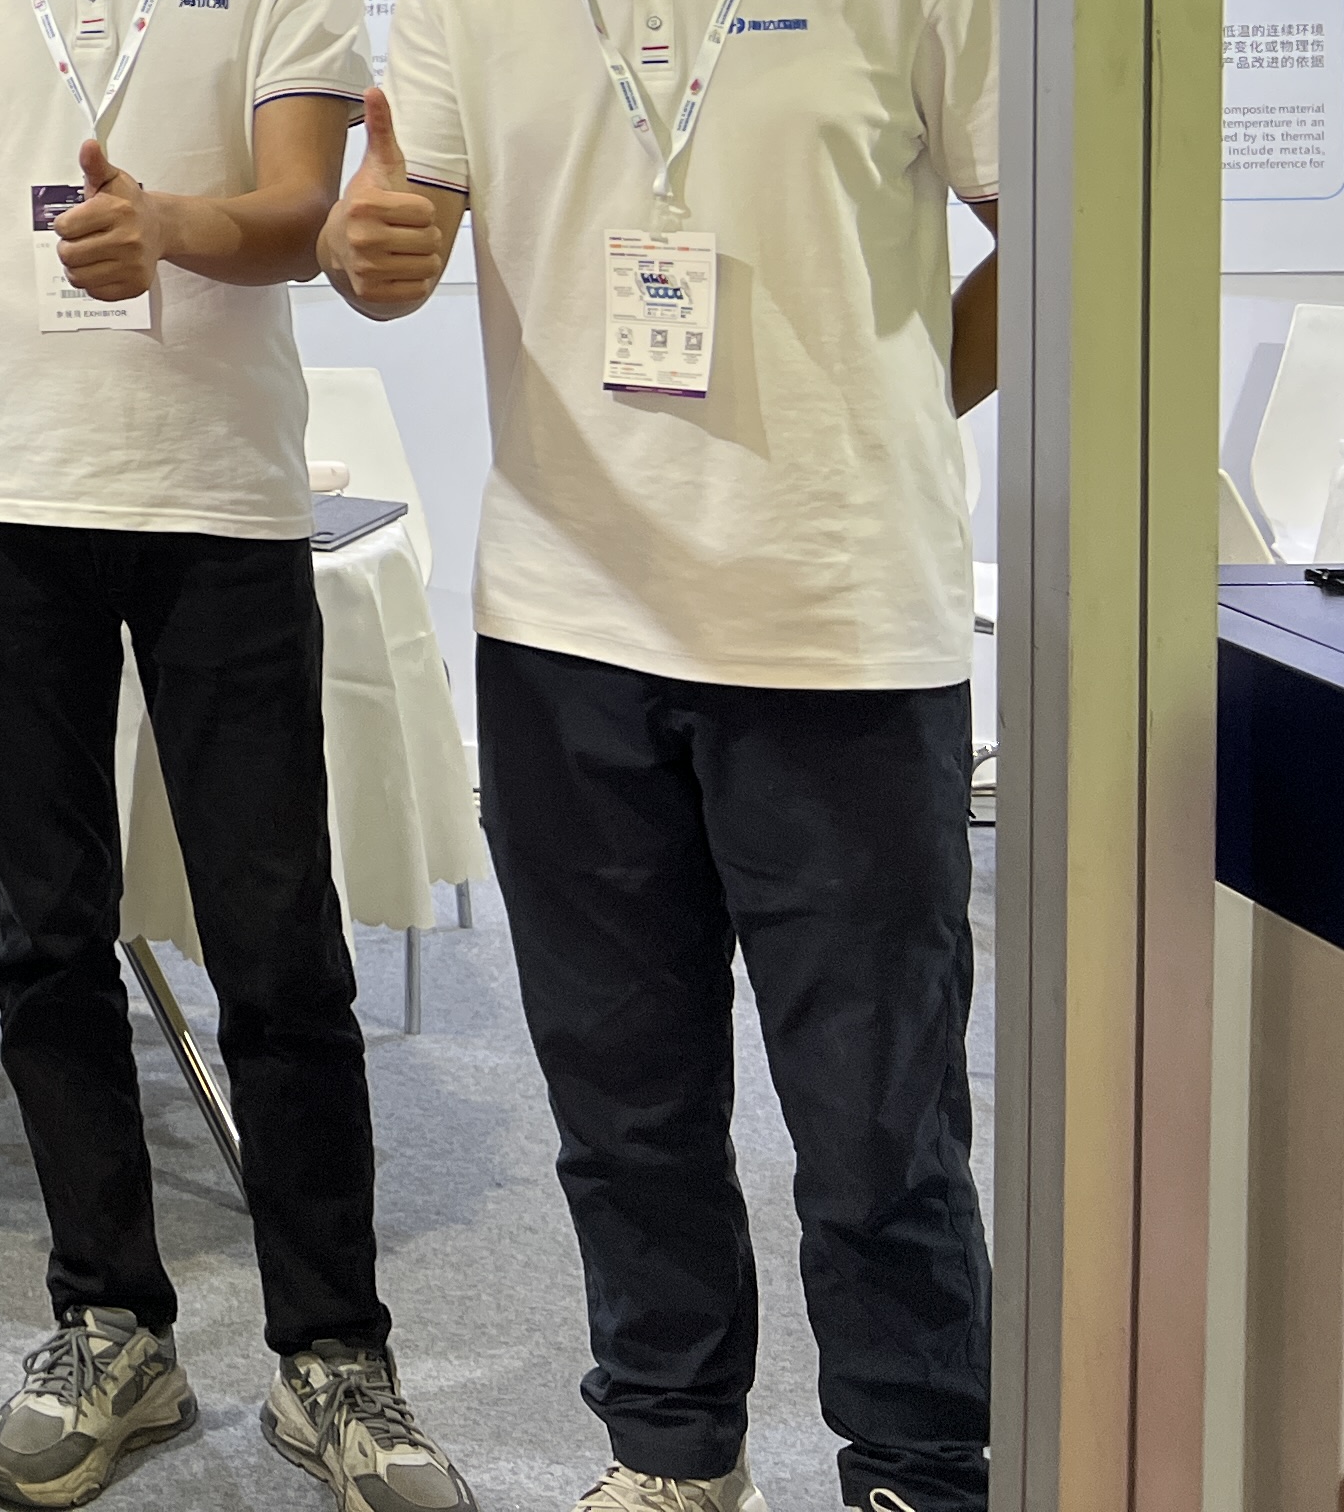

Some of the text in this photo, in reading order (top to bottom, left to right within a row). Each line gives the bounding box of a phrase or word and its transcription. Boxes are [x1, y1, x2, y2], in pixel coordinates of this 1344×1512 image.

[1278, 103, 1325, 114] material
[1296, 117, 1307, 127] in
[1310, 118, 1325, 127] an
[1243, 130, 1325, 144] by its thermal
[1309, 157, 1325, 169] for
[83, 309, 127, 318] EXHIBITOR
